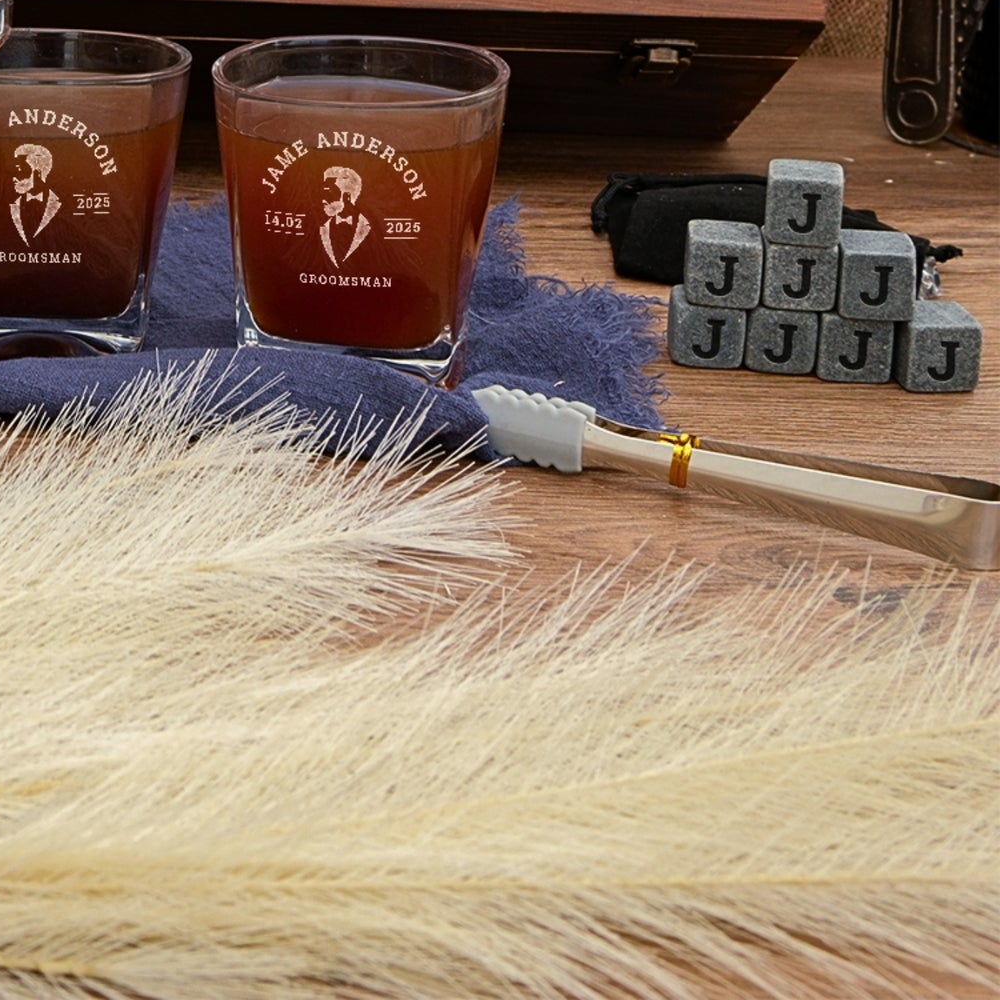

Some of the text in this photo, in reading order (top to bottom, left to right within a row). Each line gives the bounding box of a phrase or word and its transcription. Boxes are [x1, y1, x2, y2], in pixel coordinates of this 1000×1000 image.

[8, 108, 118, 176] ANDERSON
[262, 131, 428, 200] JAME ANDERSON
[76, 197, 110, 209] 2025
[264, 214, 302, 229] 14.02
[787, 193, 822, 234] J
[386, 222, 421, 233] 2025
[299, 272, 392, 287] GROOMSMAN
[705, 255, 739, 297] J
[782, 258, 817, 299] J
[859, 265, 893, 306] J
[692, 318, 726, 360] J
[764, 323, 799, 364] J
[838, 330, 873, 371] J
[927, 340, 961, 382] J
